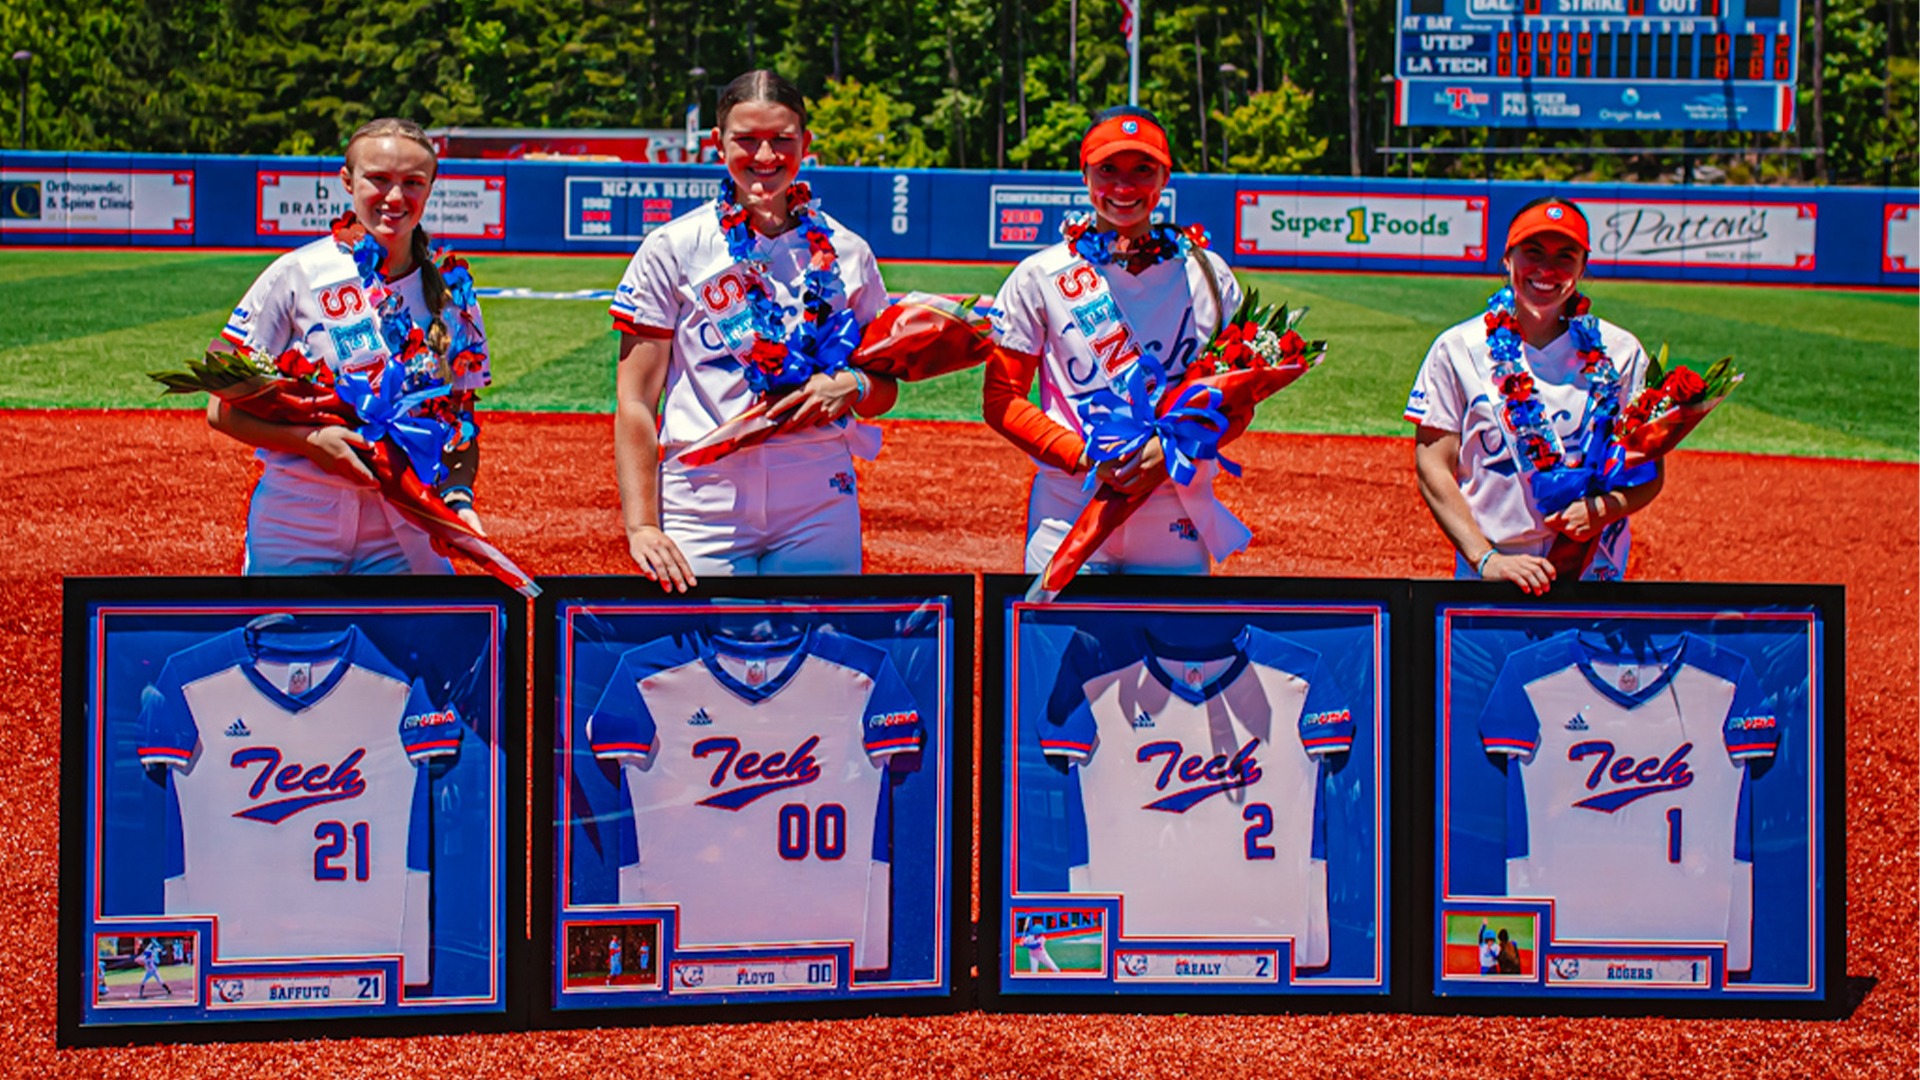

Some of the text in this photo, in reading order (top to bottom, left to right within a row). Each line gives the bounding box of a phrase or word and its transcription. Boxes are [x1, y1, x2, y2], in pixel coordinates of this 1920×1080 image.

[1559, 0, 1625, 12] STRIKE
[1659, 0, 1697, 12] OUT
[1403, 16, 1421, 30] AT
[1425, 16, 1453, 30] BAT
[1503, 19, 1509, 33] 1
[1524, 19, 1530, 33] 2
[1542, 19, 1549, 33] 3
[1561, 19, 1569, 33] 4
[1581, 19, 1590, 33] 5
[1601, 19, 1610, 33] 6
[1623, 19, 1631, 33] 7
[1641, 19, 1650, 33] 8
[1662, 20, 1671, 33] 9
[1679, 20, 1695, 33] 10
[1420, 32, 1790, 56] UTEP 0 0 0 0 0 0 3 2
[1407, 57, 1432, 72] LA
[1436, 58, 1487, 73] TECH
[1497, 55, 1511, 77] 0
[1517, 55, 1532, 77] 0
[1557, 55, 1571, 77] 0
[1774, 58, 1789, 80] 0
[1599, 109, 1661, 122] Origin Bank
[46, 180, 123, 194] Orthopaedic
[315, 180, 328, 199] b
[602, 182, 721, 198] NCAA REGIO
[47, 196, 134, 211] & Spine Clinic
[279, 202, 352, 214] BRASHE
[1001, 226, 1039, 242] 2017
[1270, 206, 1450, 244] Super 1 Foods
[1600, 206, 1768, 255] Patton's
[691, 735, 821, 789] Tech
[1136, 737, 1262, 793] Tech
[1568, 740, 1694, 792] Tech
[230, 746, 366, 802] Tech
[777, 803, 847, 861] 00
[1242, 802, 1275, 860] 2
[1665, 807, 1682, 864] 1
[313, 820, 370, 882] 21
[736, 963, 832, 986] FLOYD 00
[1175, 956, 1269, 977] GREALY 2
[1607, 961, 1699, 982] ROGERS 1
[269, 977, 380, 1000] BAFFUTO 21
